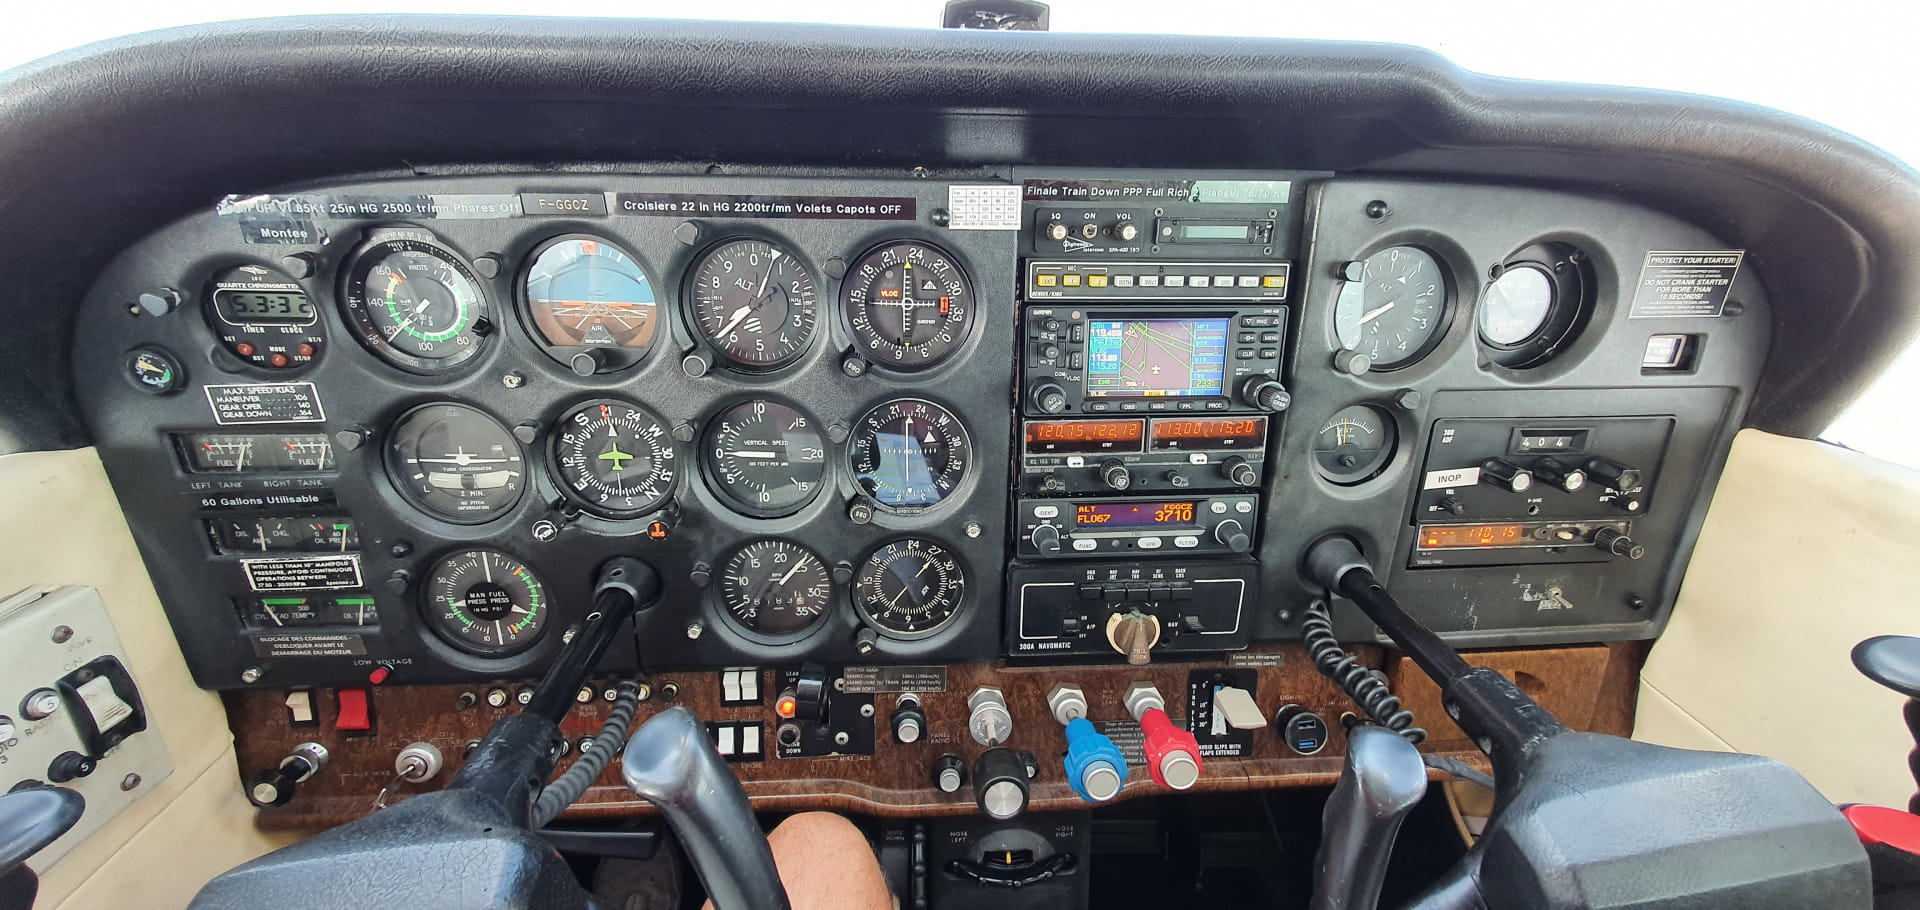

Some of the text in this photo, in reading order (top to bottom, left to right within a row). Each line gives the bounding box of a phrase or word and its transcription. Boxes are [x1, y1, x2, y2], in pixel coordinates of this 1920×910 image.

[1027, 186, 1189, 197] Finale Train Down PPP Full Rich
[360, 203, 378, 214] HG
[383, 203, 412, 213] 2500
[453, 202, 496, 213] Phares
[500, 202, 520, 213] Off
[538, 199, 589, 211] F-GGCZ
[623, 200, 901, 215] Croisiere 22 HG 2200tr/mn Volets Capots OFF
[260, 228, 308, 239] Montee
[881, 249, 896, 263] 21
[909, 247, 924, 259] 24
[750, 253, 758, 266] 0
[376, 267, 391, 276] 160
[724, 261, 733, 273] 9
[860, 264, 874, 279] 18
[933, 259, 949, 273] 27
[712, 277, 720, 288] 8
[734, 277, 754, 291] ALT
[792, 281, 799, 293] 2
[950, 280, 962, 296] 30
[850, 289, 862, 303] 15
[881, 289, 899, 297] VLOC
[367, 298, 384, 306] 140
[953, 307, 963, 322] 33
[793, 315, 801, 327] 3
[853, 317, 864, 331] 12
[384, 325, 399, 335] 120
[456, 337, 469, 345] 80
[756, 340, 764, 351] 5
[418, 343, 433, 351] 100
[753, 403, 765, 414] 10
[574, 413, 589, 426] S
[626, 409, 641, 422] 24
[722, 422, 730, 433] 5
[795, 418, 806, 428] 15
[649, 423, 664, 438] W
[1039, 423, 1137, 439] 120.75 122.12
[562, 432, 575, 445] 15
[662, 446, 674, 460] 30
[810, 449, 823, 459] 20
[216, 459, 234, 467] FUEL
[298, 458, 315, 466] FUEL
[562, 457, 575, 468] 12
[660, 468, 673, 482] 33
[1438, 474, 1462, 483] INOP
[218, 481, 243, 489] TANK
[264, 479, 323, 487] RIGHT TANK
[574, 478, 588, 491] E
[798, 482, 808, 491] 15
[645, 486, 660, 500] N
[759, 492, 770, 502] 10
[202, 494, 319, 506] 60 Gallons Utilisable
[1078, 505, 1096, 513] ALT
[1077, 514, 1111, 524] FL067
[1154, 510, 1193, 522] 3710
[928, 545, 942, 555] 27
[751, 559, 761, 568] 15
[774, 553, 787, 563] 20
[738, 577, 748, 586] 10
[863, 576, 873, 585] 15
[808, 587, 821, 597] 30
[795, 607, 808, 616] 35
[1039, 642, 1071, 650] NAVOMATIC
